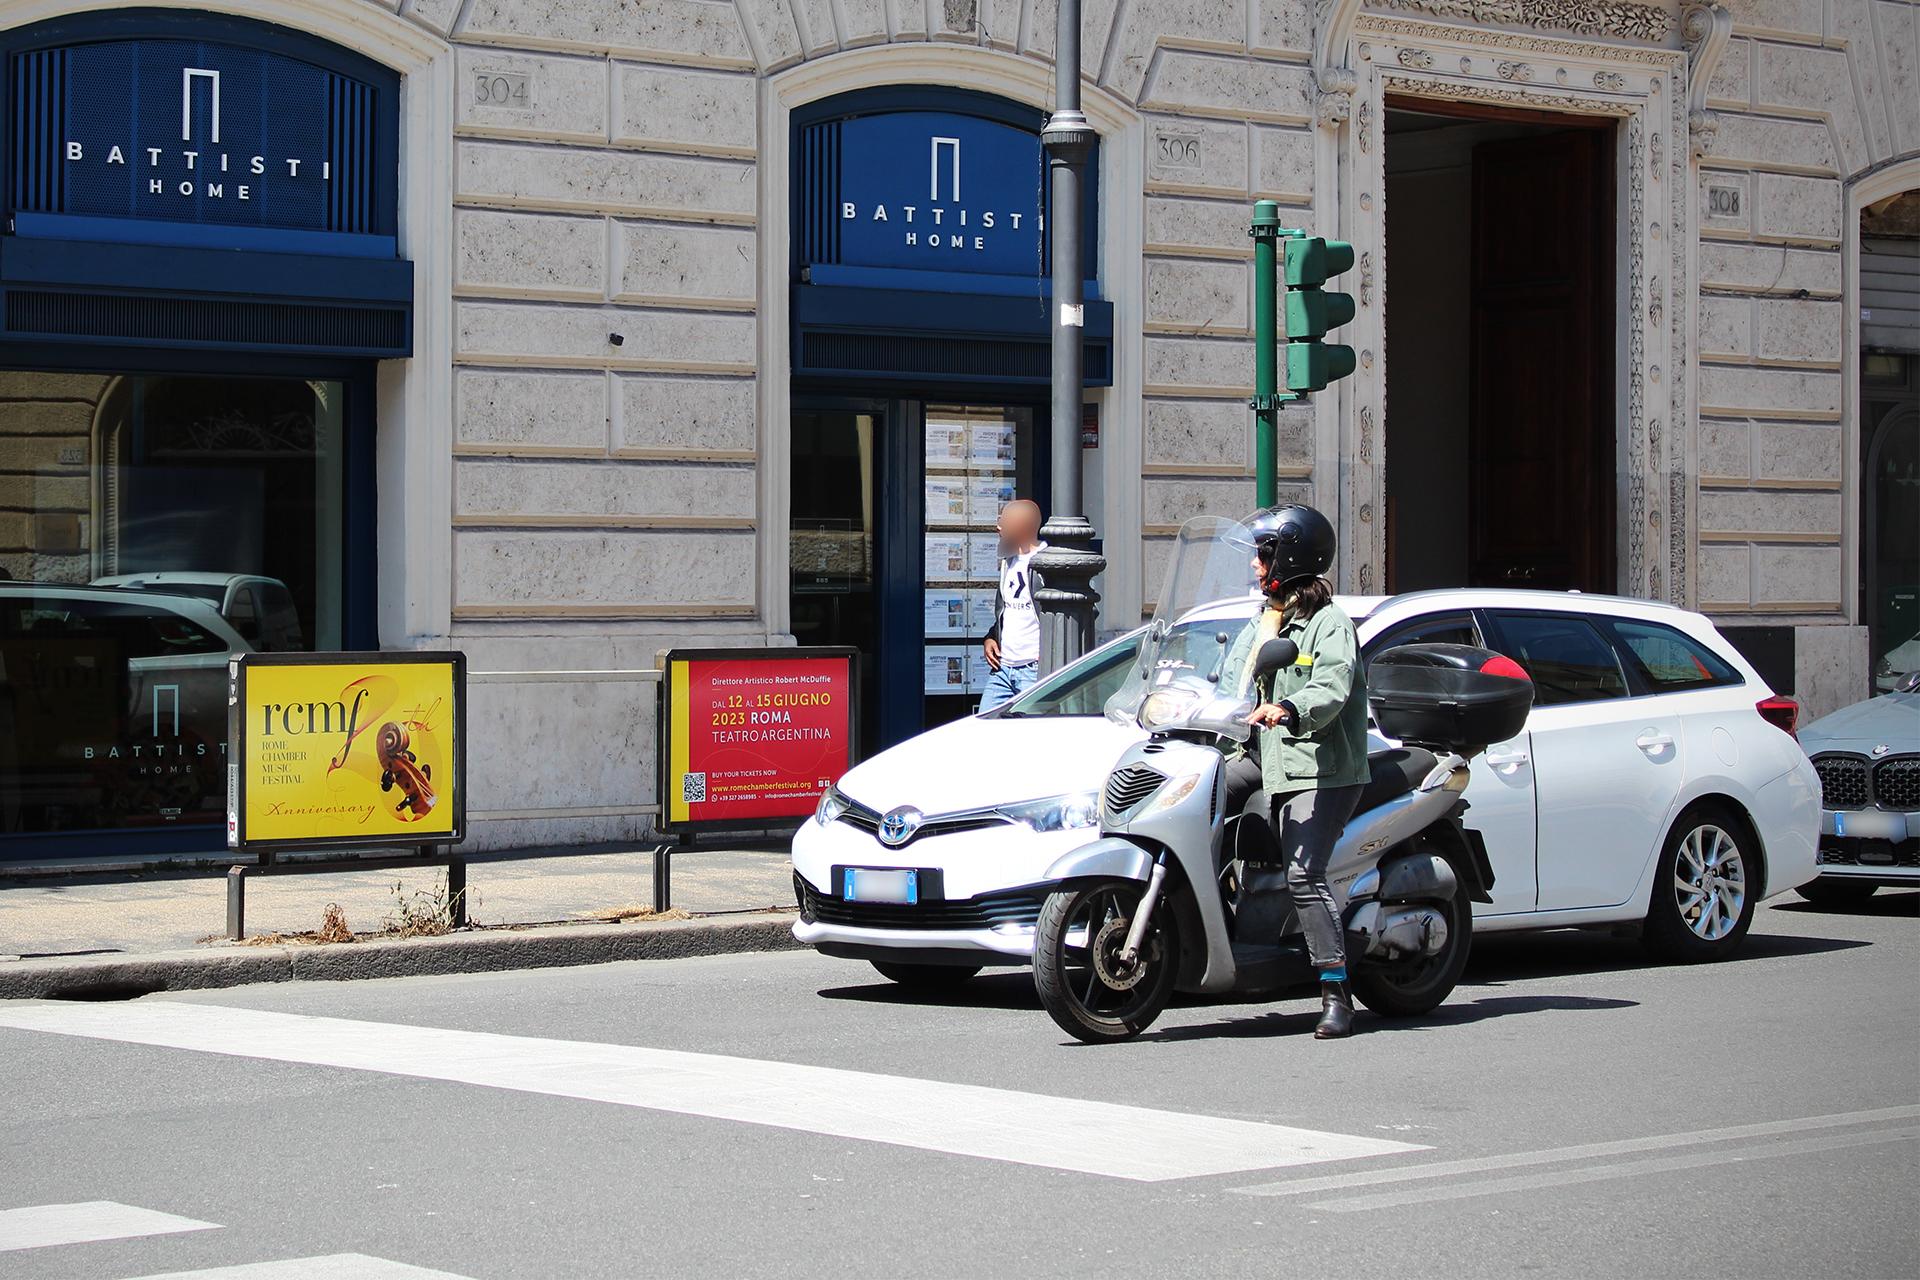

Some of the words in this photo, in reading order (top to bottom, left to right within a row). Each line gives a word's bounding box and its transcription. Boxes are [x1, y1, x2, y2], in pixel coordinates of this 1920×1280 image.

[477, 75, 529, 104] 304
[1159, 137, 1198, 162] 306
[66, 141, 330, 179] BATTISTI
[149, 179, 250, 200] HOME
[1710, 189, 1739, 213] 308
[906, 232, 984, 250] HOME
[712, 677, 743, 685] Direttore
[775, 675, 799, 684] Robert
[800, 675, 831, 683] McDuffie
[712, 700, 726, 708] DAL
[728, 695, 743, 708] 12
[756, 694, 771, 707] 15
[773, 692, 831, 707] GIUGNO
[712, 712, 745, 726] 2023
[751, 710, 792, 724] ROMA
[712, 730, 759, 743] TEATRO
[761, 727, 831, 741] ARGENTINA
[84, 743, 227, 759] BATTIST
[262, 741, 288, 750] ROME
[261, 752, 307, 761] CHAMBER
[140, 765, 192, 774] HOME
[262, 764, 291, 773] MUSIC
[262, 774, 304, 784] FESTIVAL
[712, 781, 812, 792] www.romechamberfestival.org
[765, 791, 822, 799] info@romechamberfestival
